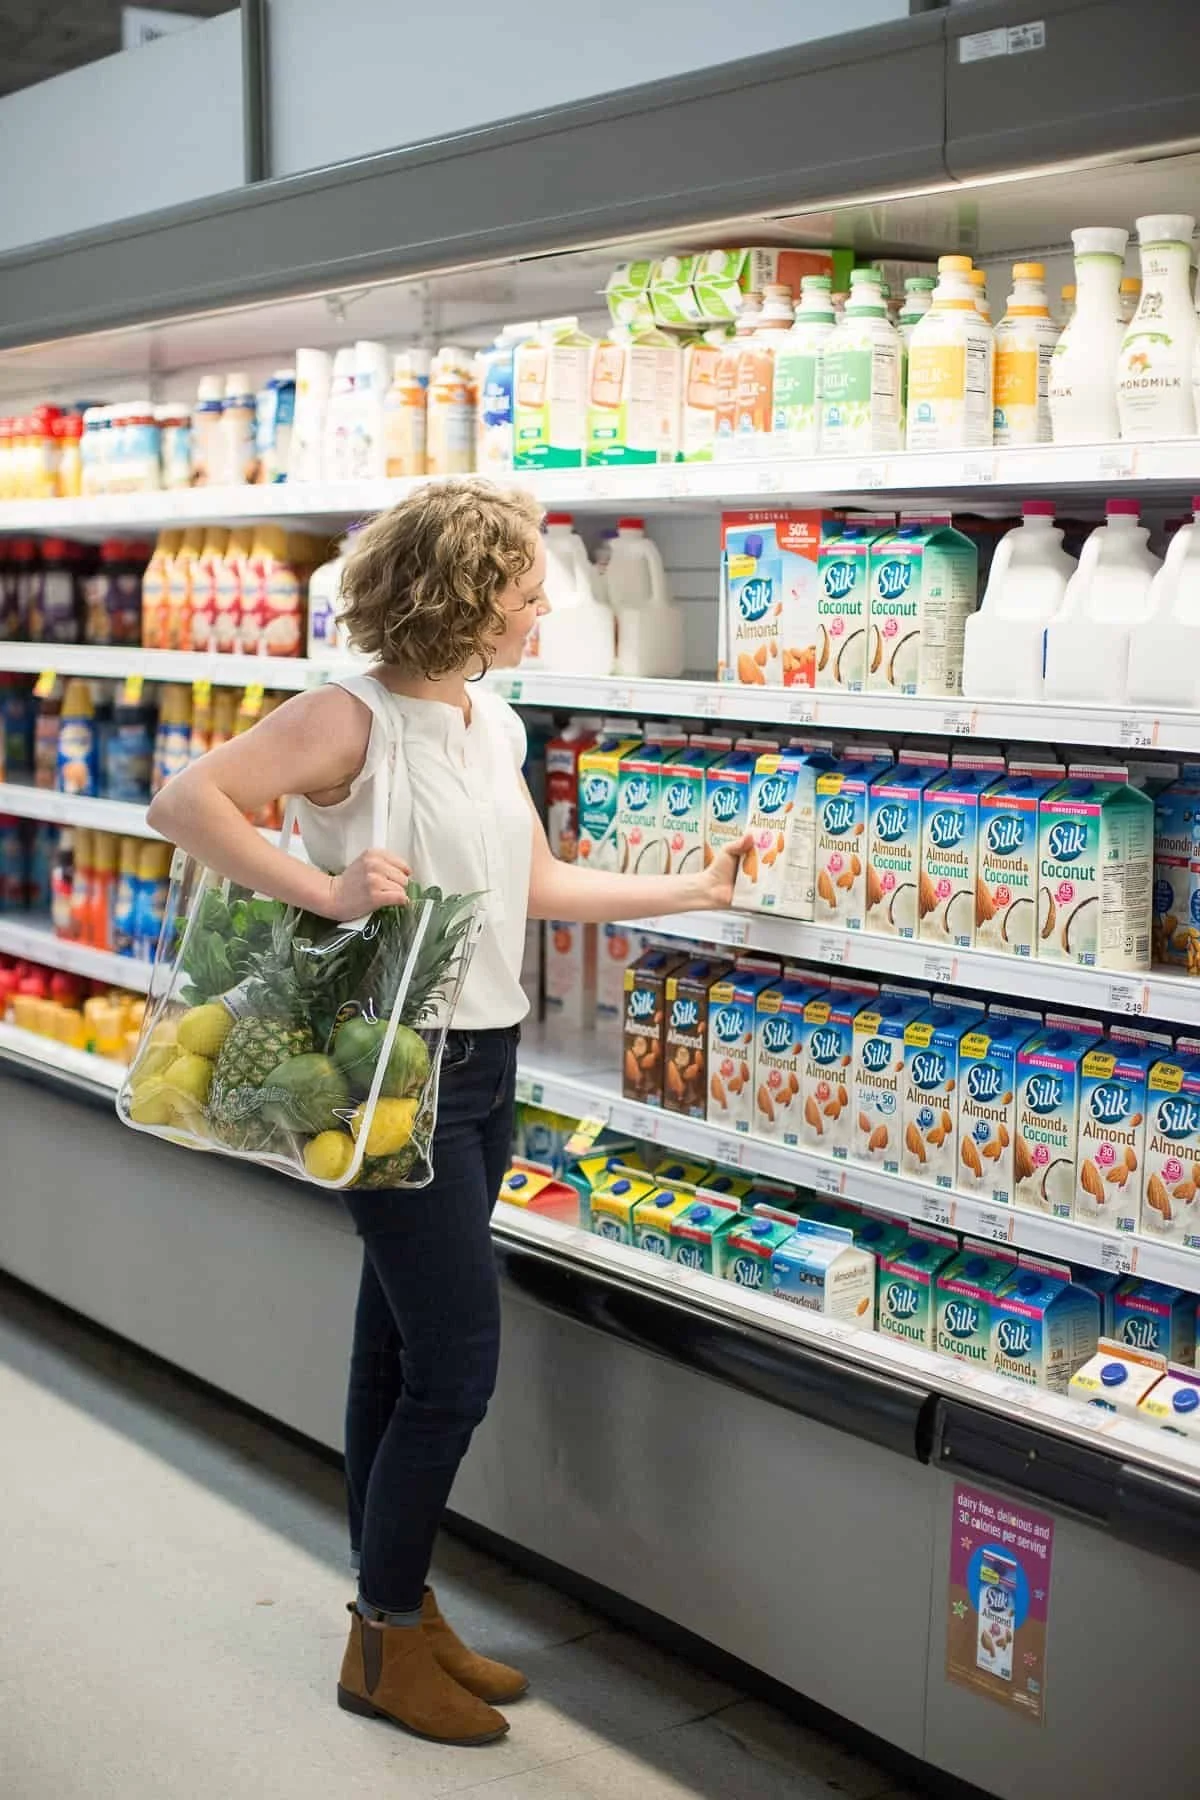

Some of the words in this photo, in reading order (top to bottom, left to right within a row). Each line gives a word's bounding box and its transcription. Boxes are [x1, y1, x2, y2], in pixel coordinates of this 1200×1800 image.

[748, 512, 790, 520] ORIGINAL
[789, 523, 808, 537] 50%
[824, 563, 856, 597] Silk
[878, 563, 912, 596] Silk
[738, 580, 772, 618] Silk
[818, 600, 862, 615] Coconut
[872, 600, 917, 616] Coconut
[736, 621, 778, 640] Almond
[625, 780, 650, 807] Silk
[668, 786, 693, 813] Silk
[713, 791, 739, 818] Silk
[758, 781, 787, 810] Silk
[620, 810, 656, 827] Coconut
[663, 815, 699, 833] Coconut
[750, 814, 786, 830] Almond
[824, 802, 855, 832] Silk
[877, 808, 908, 838] Silk
[930, 814, 966, 844] Silk
[987, 819, 1024, 850] Silk
[819, 837, 859, 853] Almond
[1049, 825, 1088, 856] Silk
[874, 855, 912, 872] Coconut
[928, 861, 968, 879] Coconut
[1041, 860, 1095, 881] Coconut
[985, 868, 1029, 886] Coconut
[1061, 885, 1071, 894] 45
[628, 991, 654, 1016] Silk
[671, 1001, 698, 1026] Silk
[1125, 1002, 1142, 1013] 2.49
[625, 1019, 660, 1039] Almond
[715, 1010, 743, 1037] Silk
[763, 1021, 793, 1047] Silk
[666, 1029, 703, 1049] Almond
[712, 1040, 747, 1060] Almond
[810, 1032, 841, 1060] Silk
[759, 1052, 796, 1071] Almond
[863, 1042, 892, 1067] Silk
[1092, 1054, 1109, 1062] NEW
[806, 1063, 846, 1083] Almond
[856, 1070, 897, 1090] Almond
[912, 1056, 945, 1083] Silk
[1160, 1066, 1178, 1075] NEW
[968, 1067, 1001, 1096] Silk
[883, 1095, 893, 1104] 50
[907, 1088, 950, 1110] Almond
[1025, 1079, 1062, 1108] Silk
[1089, 1088, 1130, 1119] Silk
[962, 1101, 1008, 1123] Almond
[1157, 1101, 1200, 1133] Silk
[1023, 1126, 1068, 1147] Coconut
[1083, 1122, 1136, 1146] Almond
[1102, 1148, 1113, 1157] 30
[1169, 1162, 1180, 1172] 30
[935, 1214, 949, 1224] 2.99
[992, 1229, 1008, 1240] 2.99
[734, 1260, 763, 1287] Silk
[1115, 1260, 1131, 1272] 2.99
[888, 1285, 918, 1313] Silk
[881, 1313, 925, 1342] Coconut
[945, 1303, 978, 1331] Silk
[998, 1322, 1032, 1351] Silk
[1124, 1319, 1160, 1348] Silk
[938, 1332, 987, 1361] Coconut
[958, 1493, 977, 1512] dairy
[997, 1508, 1032, 1533] delicious
[1034, 1524, 1050, 1540] and
[959, 1510, 969, 1525] 30
[971, 1518, 1001, 1538] calories
[1002, 1530, 1017, 1544] per
[1017, 1536, 1047, 1559] serving
[987, 1587, 1009, 1609] Silk
[982, 1608, 1012, 1627] Almond
